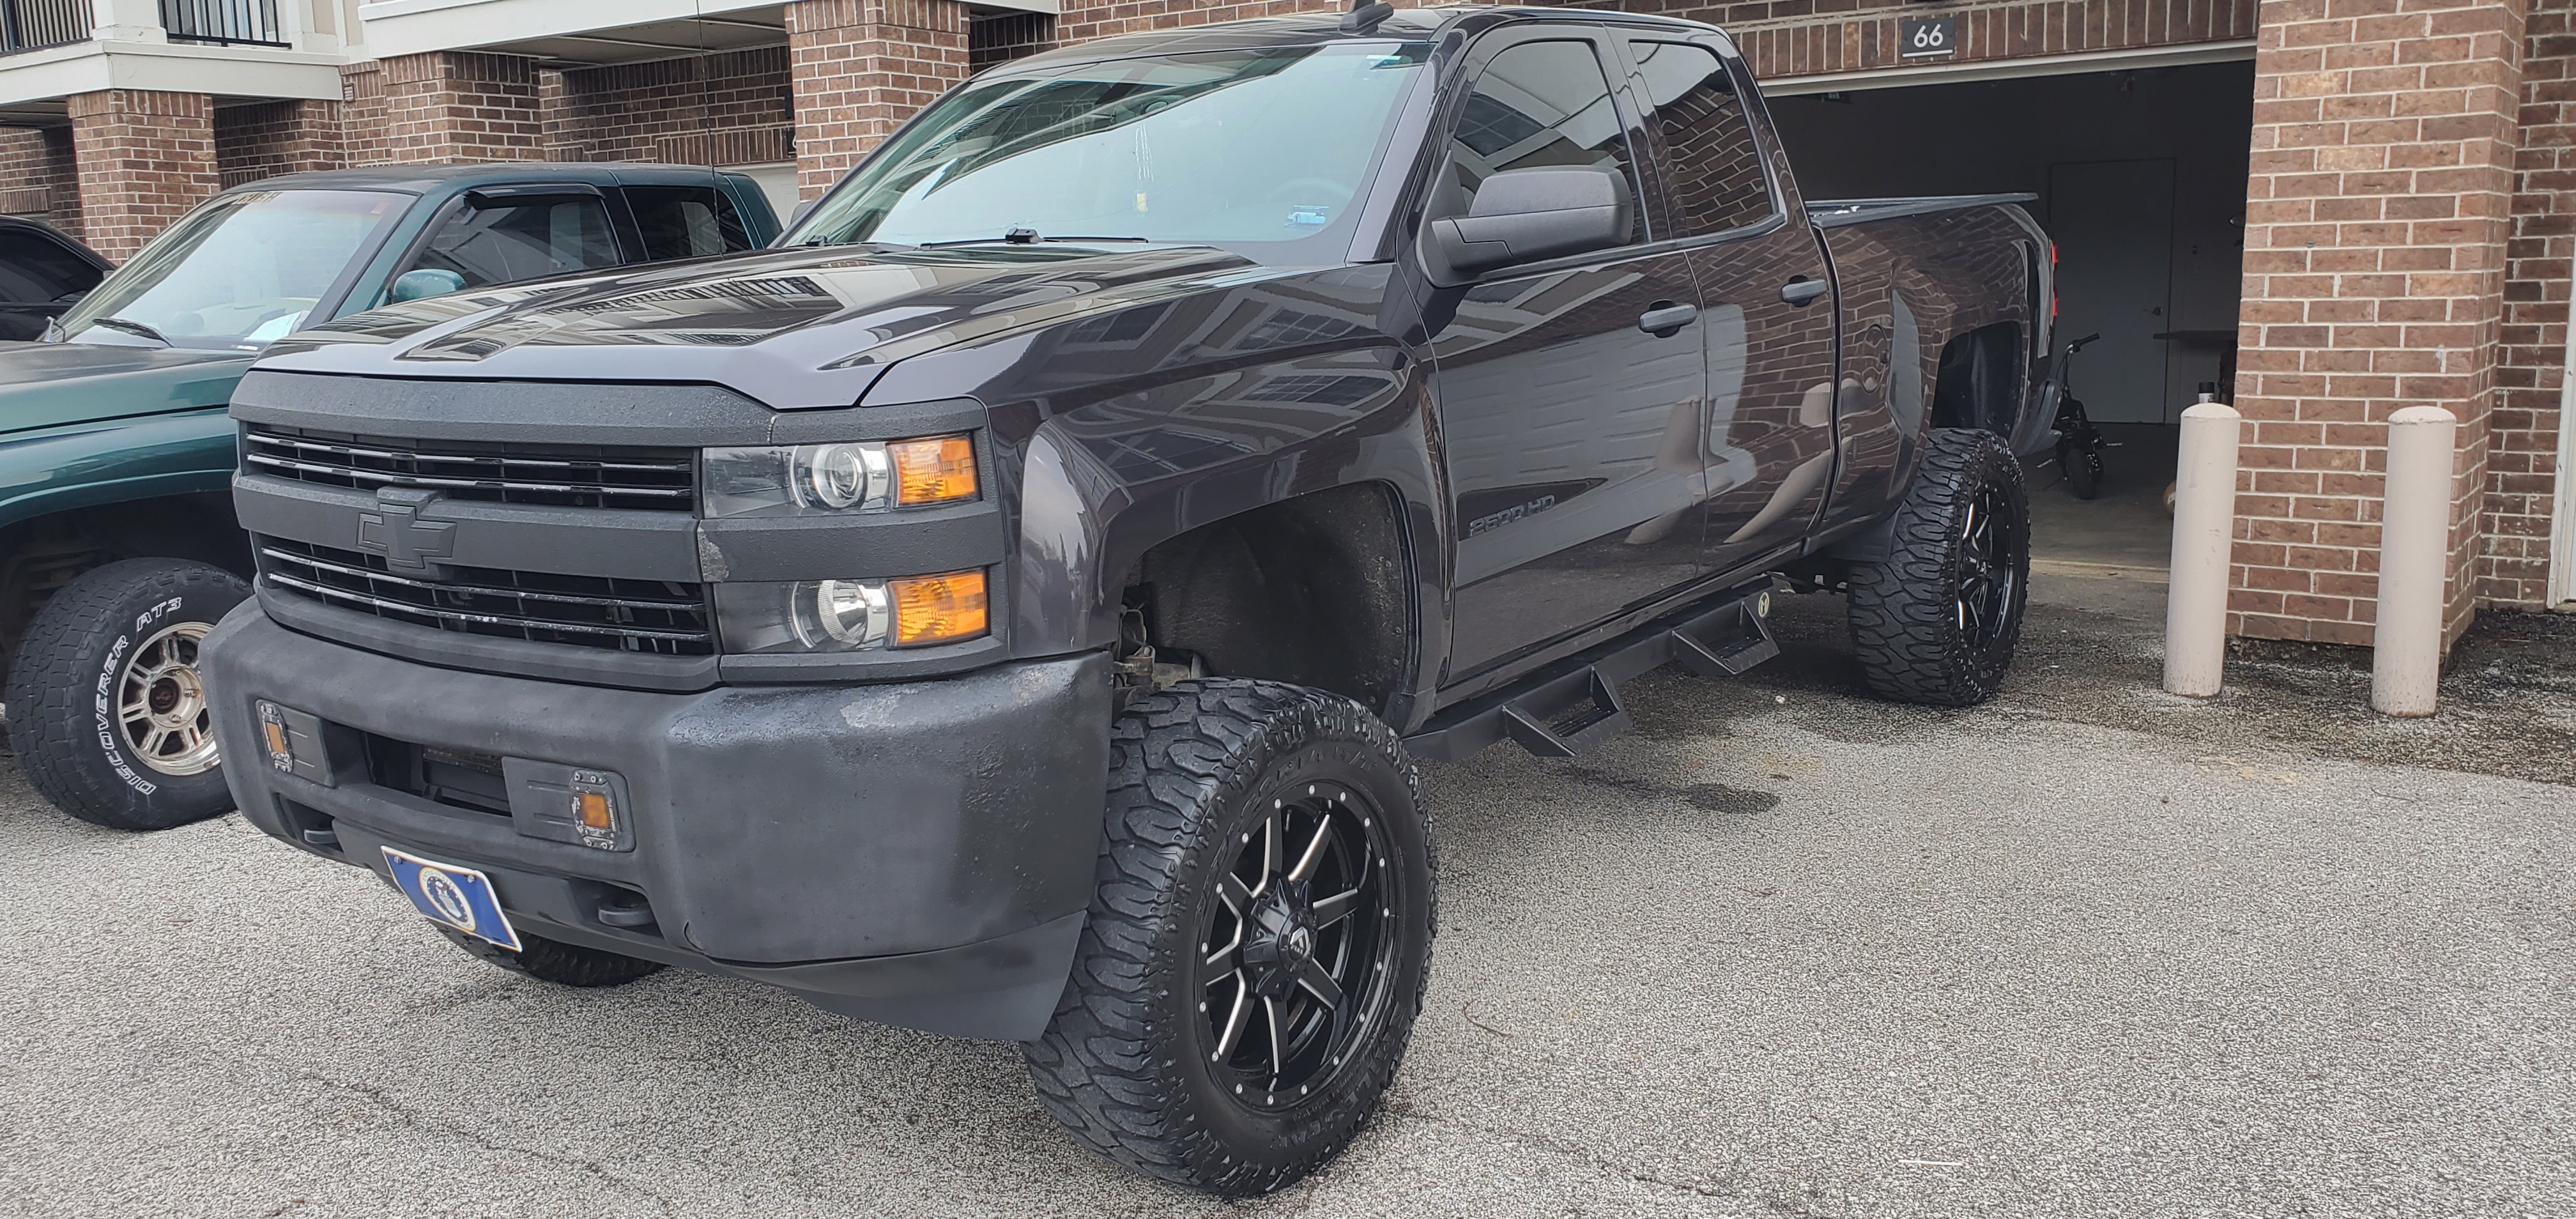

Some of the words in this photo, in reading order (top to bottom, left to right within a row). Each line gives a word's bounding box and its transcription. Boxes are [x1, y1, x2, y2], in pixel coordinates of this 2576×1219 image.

[1913, 23, 1943, 48] 66
[1469, 505, 1525, 537] 2500
[1527, 494, 1556, 518] HD
[96, 634, 157, 795] DISCOVERER
[136, 597, 182, 632] AT3
